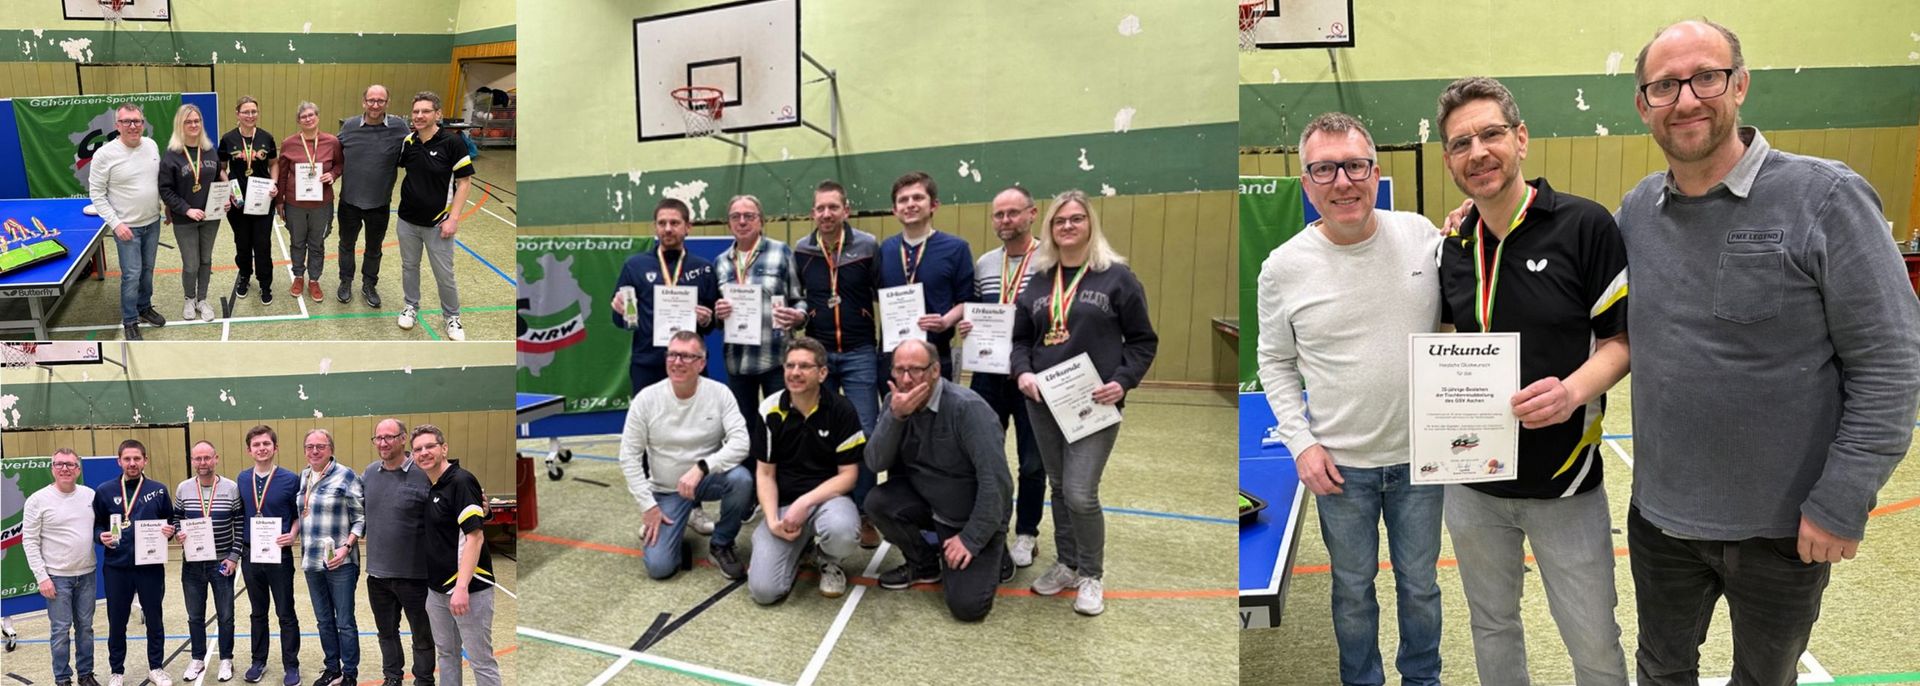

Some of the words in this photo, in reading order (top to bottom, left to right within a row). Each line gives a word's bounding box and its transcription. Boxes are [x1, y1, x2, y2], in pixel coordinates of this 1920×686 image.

[18, 288, 54, 297] Butterfly
[529, 319, 578, 341] NRW
[1428, 343, 1501, 357] Urkunde
